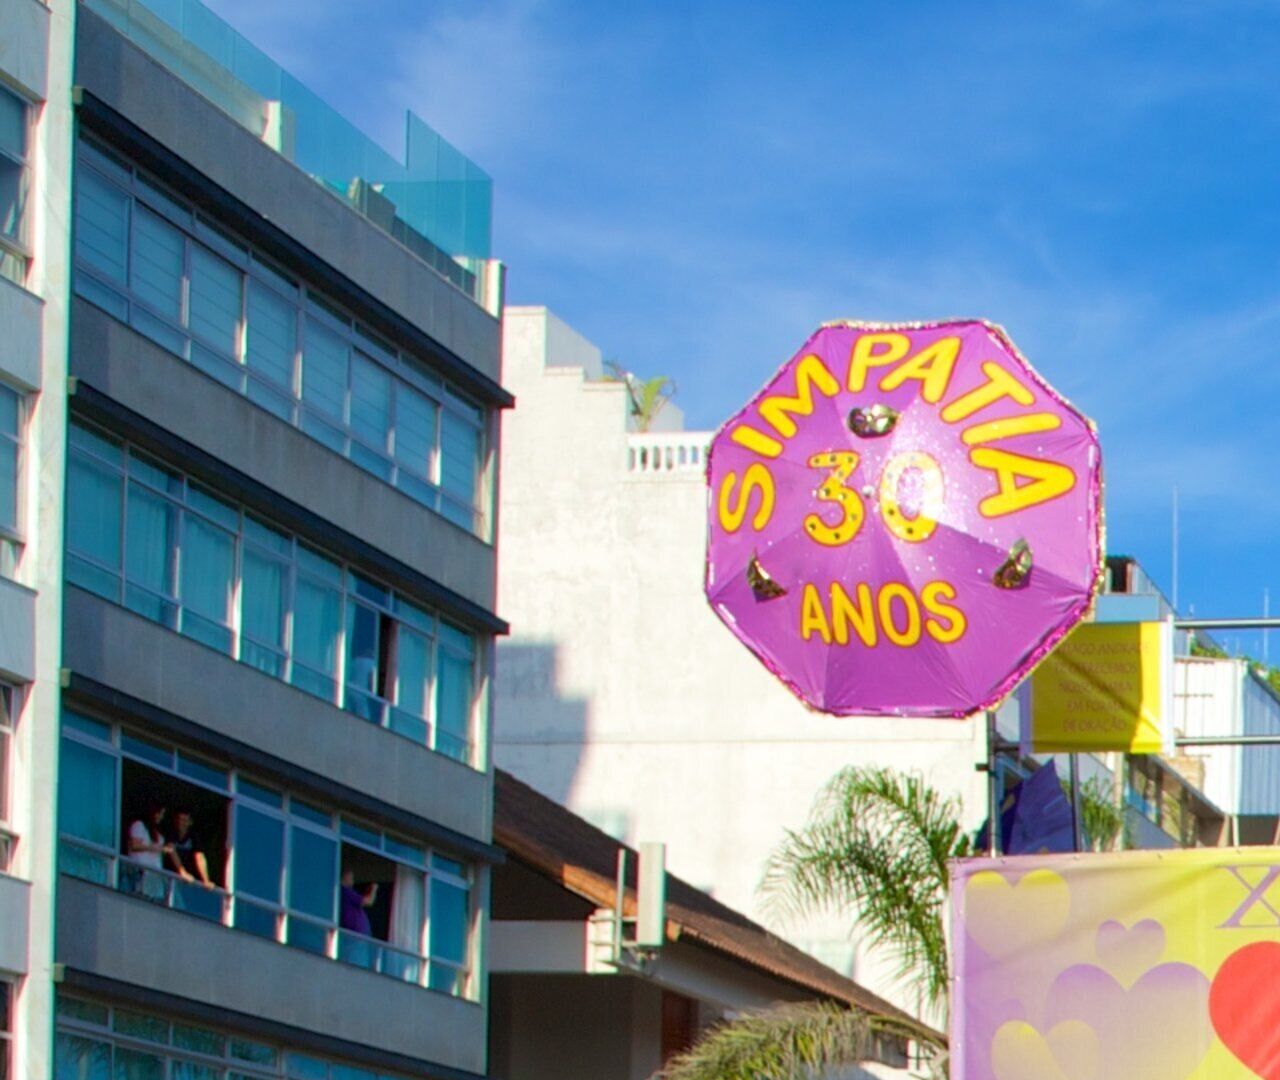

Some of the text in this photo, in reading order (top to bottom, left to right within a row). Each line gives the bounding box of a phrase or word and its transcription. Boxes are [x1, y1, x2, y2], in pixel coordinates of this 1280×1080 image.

[718, 333, 1077, 534] SIMPATIA
[803, 451, 946, 547] 30
[801, 580, 968, 648] ANOS
